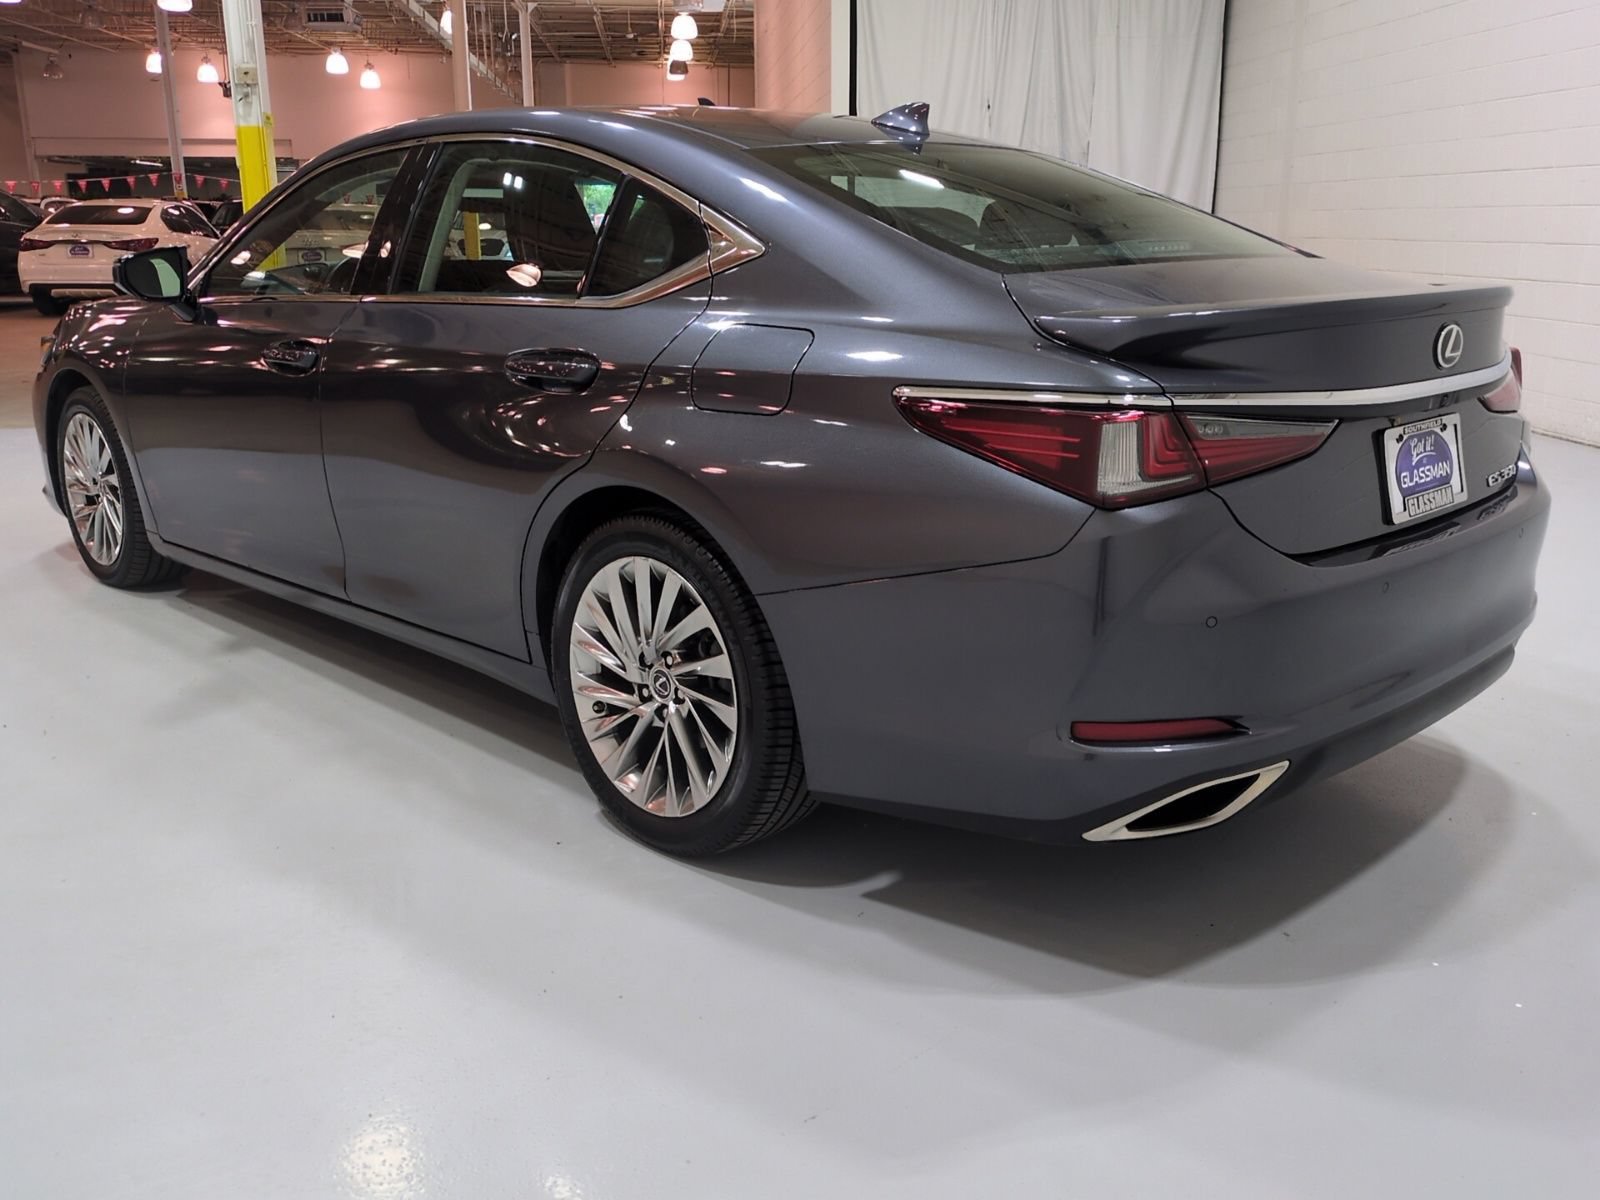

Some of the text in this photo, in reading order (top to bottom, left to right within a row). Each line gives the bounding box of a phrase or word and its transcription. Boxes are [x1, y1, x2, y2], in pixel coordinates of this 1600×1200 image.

[1410, 434, 1435, 458] Got it!
[1401, 461, 1450, 488] GLASSMAN
[1408, 486, 1453, 516] GLASSMAN
